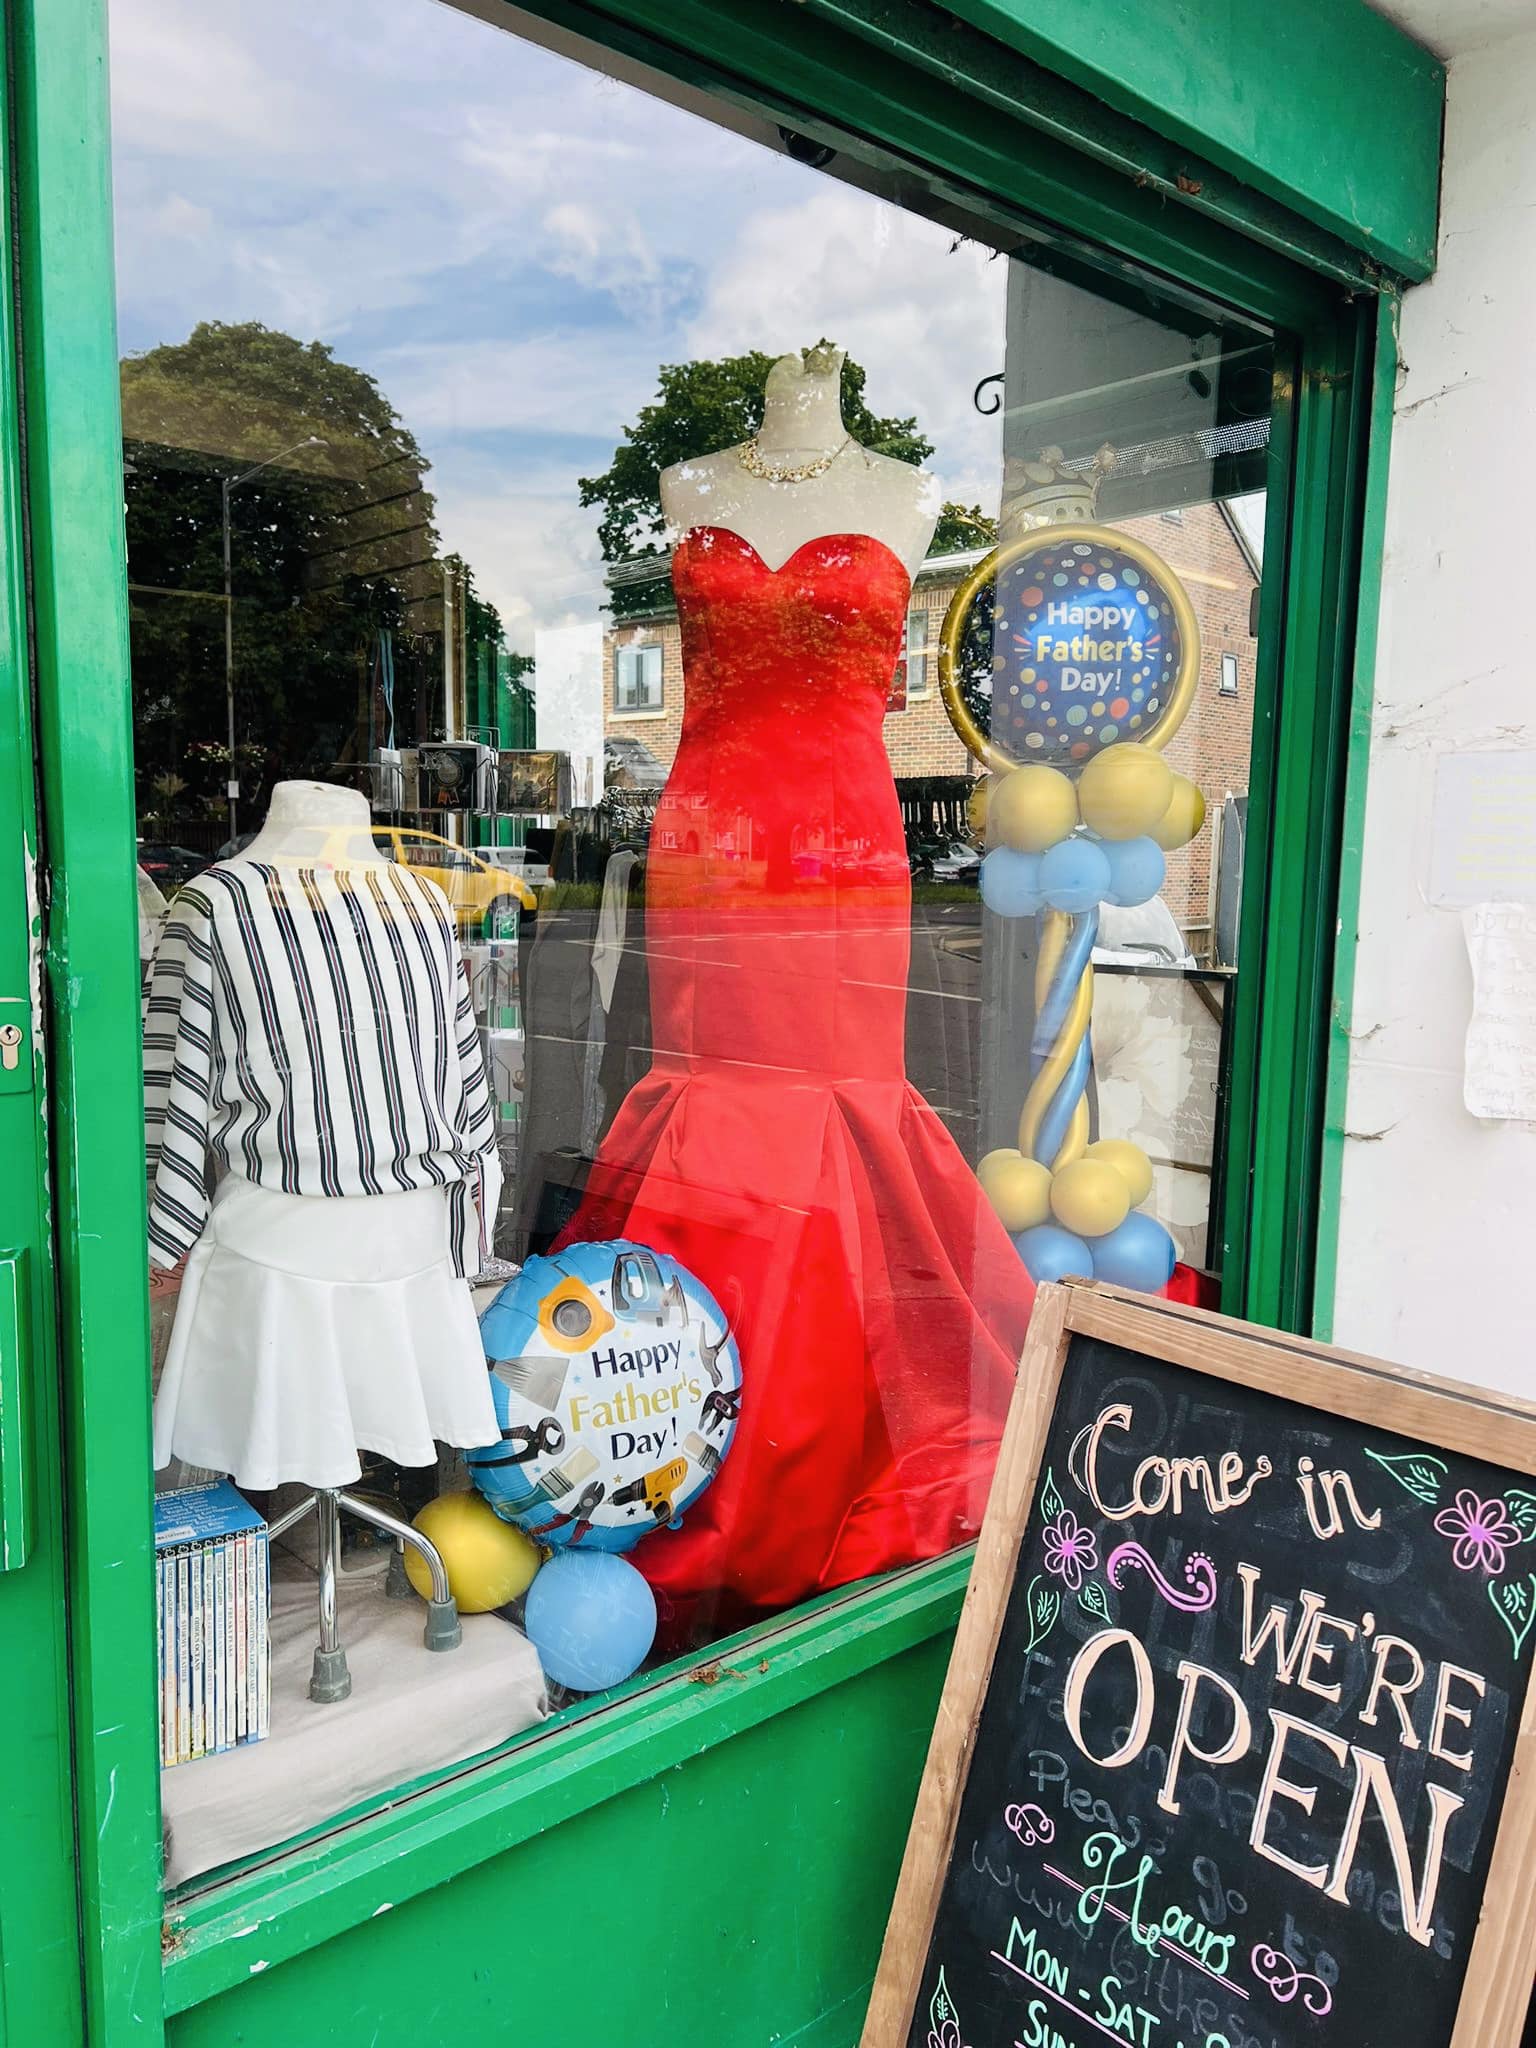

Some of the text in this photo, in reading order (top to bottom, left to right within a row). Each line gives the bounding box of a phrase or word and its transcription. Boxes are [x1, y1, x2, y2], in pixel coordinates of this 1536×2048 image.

[1047, 602, 1136, 630] Happy
[1036, 635, 1143, 663] Father's
[1060, 667, 1122, 697] Day!
[592, 1340, 681, 1378] Happy
[569, 1371, 703, 1433] Father's
[610, 1417, 678, 1461] Day!
[1068, 1403, 1273, 1521] Come
[1296, 1456, 1382, 1540] in
[1237, 1562, 1486, 1771] WE'RE
[1063, 1628, 1465, 1948] OPEN
[1078, 1831, 1236, 1975] Hours
[1005, 1915, 1069, 1996] MON
[1095, 1975, 1161, 2048] SAT
